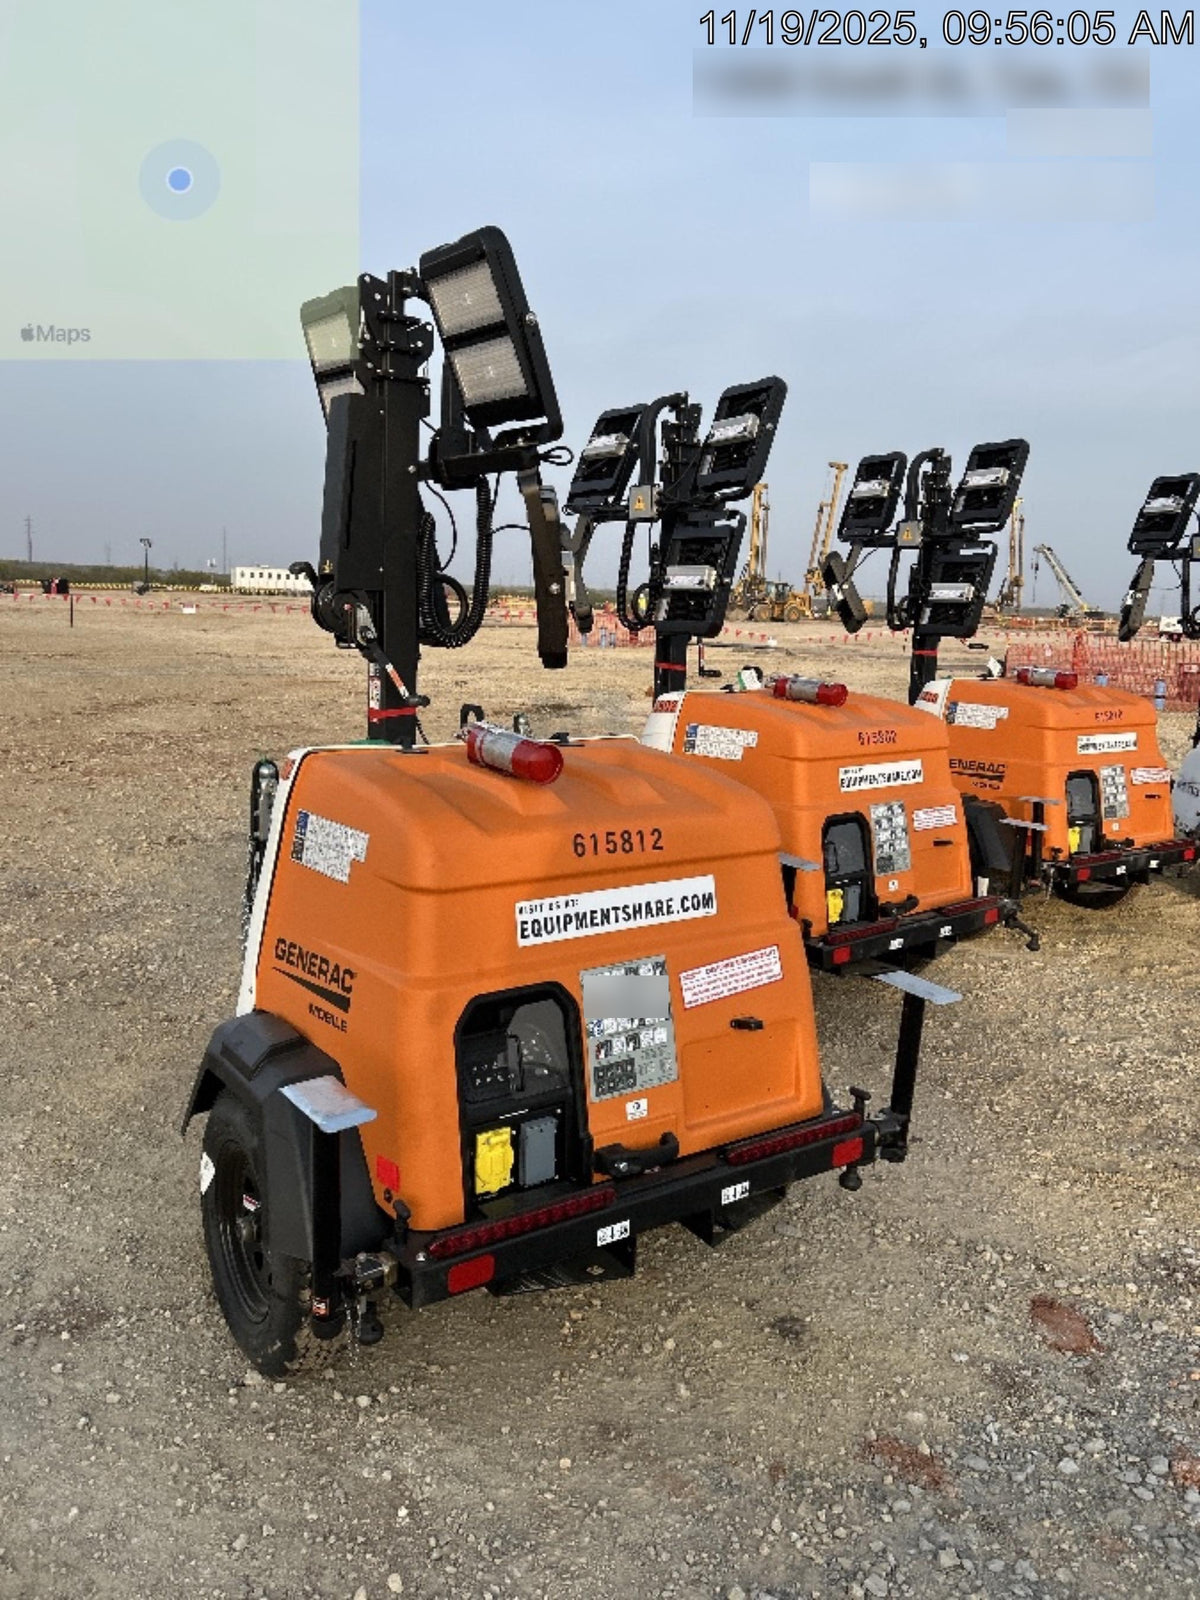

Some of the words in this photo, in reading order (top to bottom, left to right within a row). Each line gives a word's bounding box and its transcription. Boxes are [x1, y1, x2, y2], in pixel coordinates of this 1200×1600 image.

[949, 758, 1006, 774] ENERAC
[572, 828, 664, 857] 615812
[520, 892, 714, 939] EQUIPMENTSHARE.COM
[275, 937, 355, 994] GENERAC
